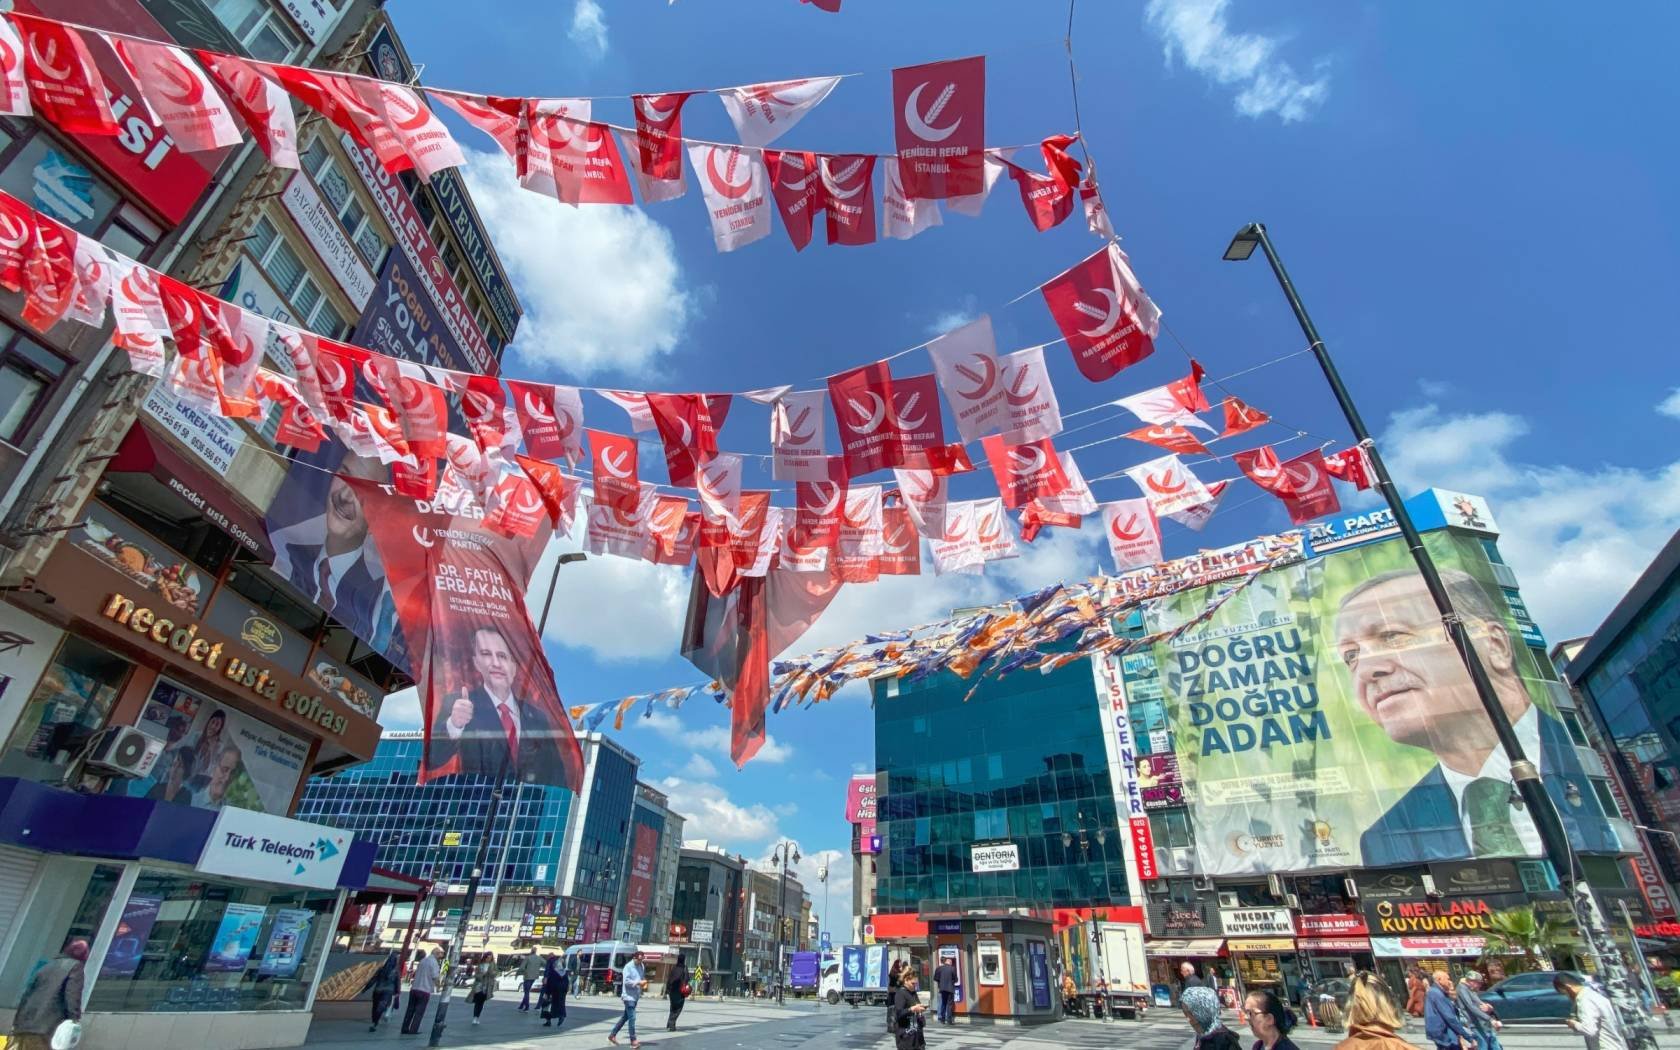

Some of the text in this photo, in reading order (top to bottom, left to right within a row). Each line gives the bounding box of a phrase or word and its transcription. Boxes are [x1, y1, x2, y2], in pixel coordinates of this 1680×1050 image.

[900, 145, 968, 160] YENİDEN REFAH
[915, 161, 950, 174] İSTANBUL
[714, 204, 743, 220] YENİDEN
[362, 147, 492, 371] ADALET PARTİSİ
[385, 280, 429, 364] YOLA
[147, 399, 164, 417] 0212
[175, 401, 236, 458] EKREM ALKAN
[169, 476, 206, 510] necdet
[206, 504, 229, 530] usta
[1344, 508, 1395, 531] PART
[438, 563, 504, 586] DR. FATİH
[434, 575, 513, 602] ERBAKAN
[103, 592, 225, 671] necdet
[224, 656, 281, 701] usta
[1178, 628, 1302, 674] DOĞRU
[1184, 654, 1312, 697] ZAMAN
[1190, 682, 1320, 726] DOĞRU
[1201, 710, 1332, 757] ADAM
[225, 832, 315, 861] Türk Telekom
[1233, 912, 1276, 921] NECDET
[1398, 900, 1492, 917] MEVLANA
[489, 925, 514, 934] Optik
[1380, 914, 1496, 932] KUYUMCUL
